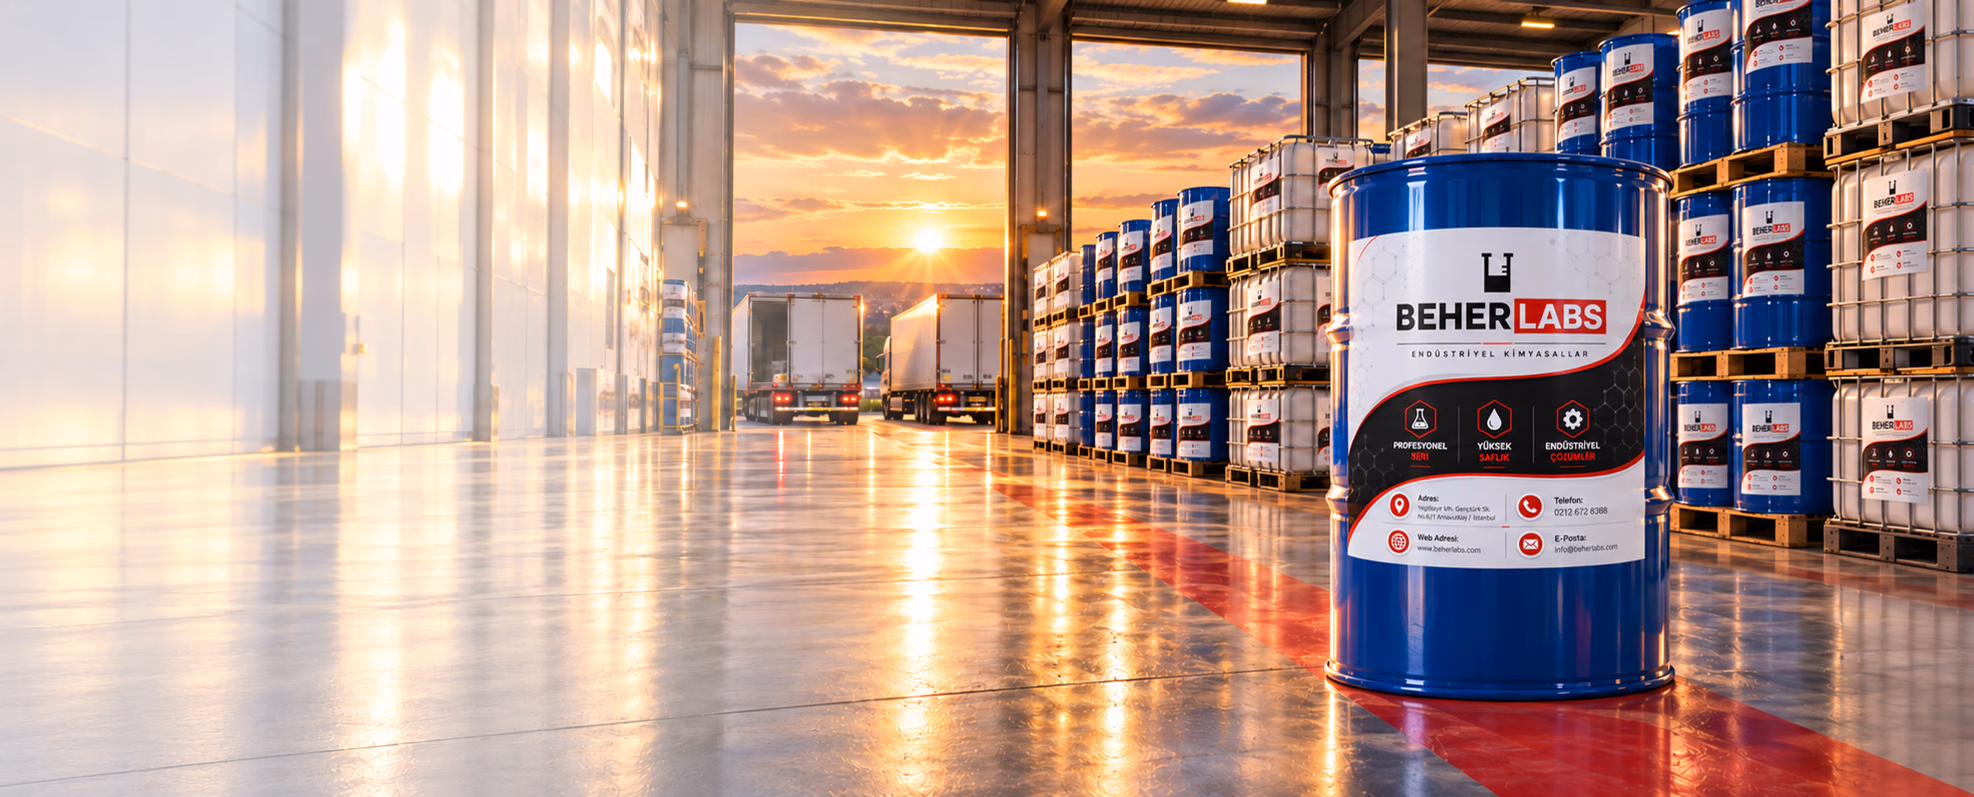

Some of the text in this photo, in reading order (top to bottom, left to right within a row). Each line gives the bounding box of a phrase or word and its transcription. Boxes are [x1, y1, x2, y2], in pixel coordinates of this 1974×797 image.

[1411, 348, 1589, 358] ENDÜSTRİYEL KİMYASALLAR
[1393, 441, 1448, 451] PROFESYONEL
[1477, 440, 1512, 450] YÜKSEK
[1545, 440, 1600, 450] ENDÜSTRİYEL
[1479, 453, 1510, 462] SAFLIK
[1417, 494, 1439, 503] Adres:
[1554, 496, 1583, 505] Telefon:
[1554, 508, 1572, 517] 0212
[1574, 507, 1588, 516] 672
[1417, 533, 1459, 543] Web Adresi:
[1554, 534, 1586, 543] E-Posta:
[1417, 545, 1481, 554] www.beherlabs.com
[1554, 544, 1618, 555] info@beherlabs.com
